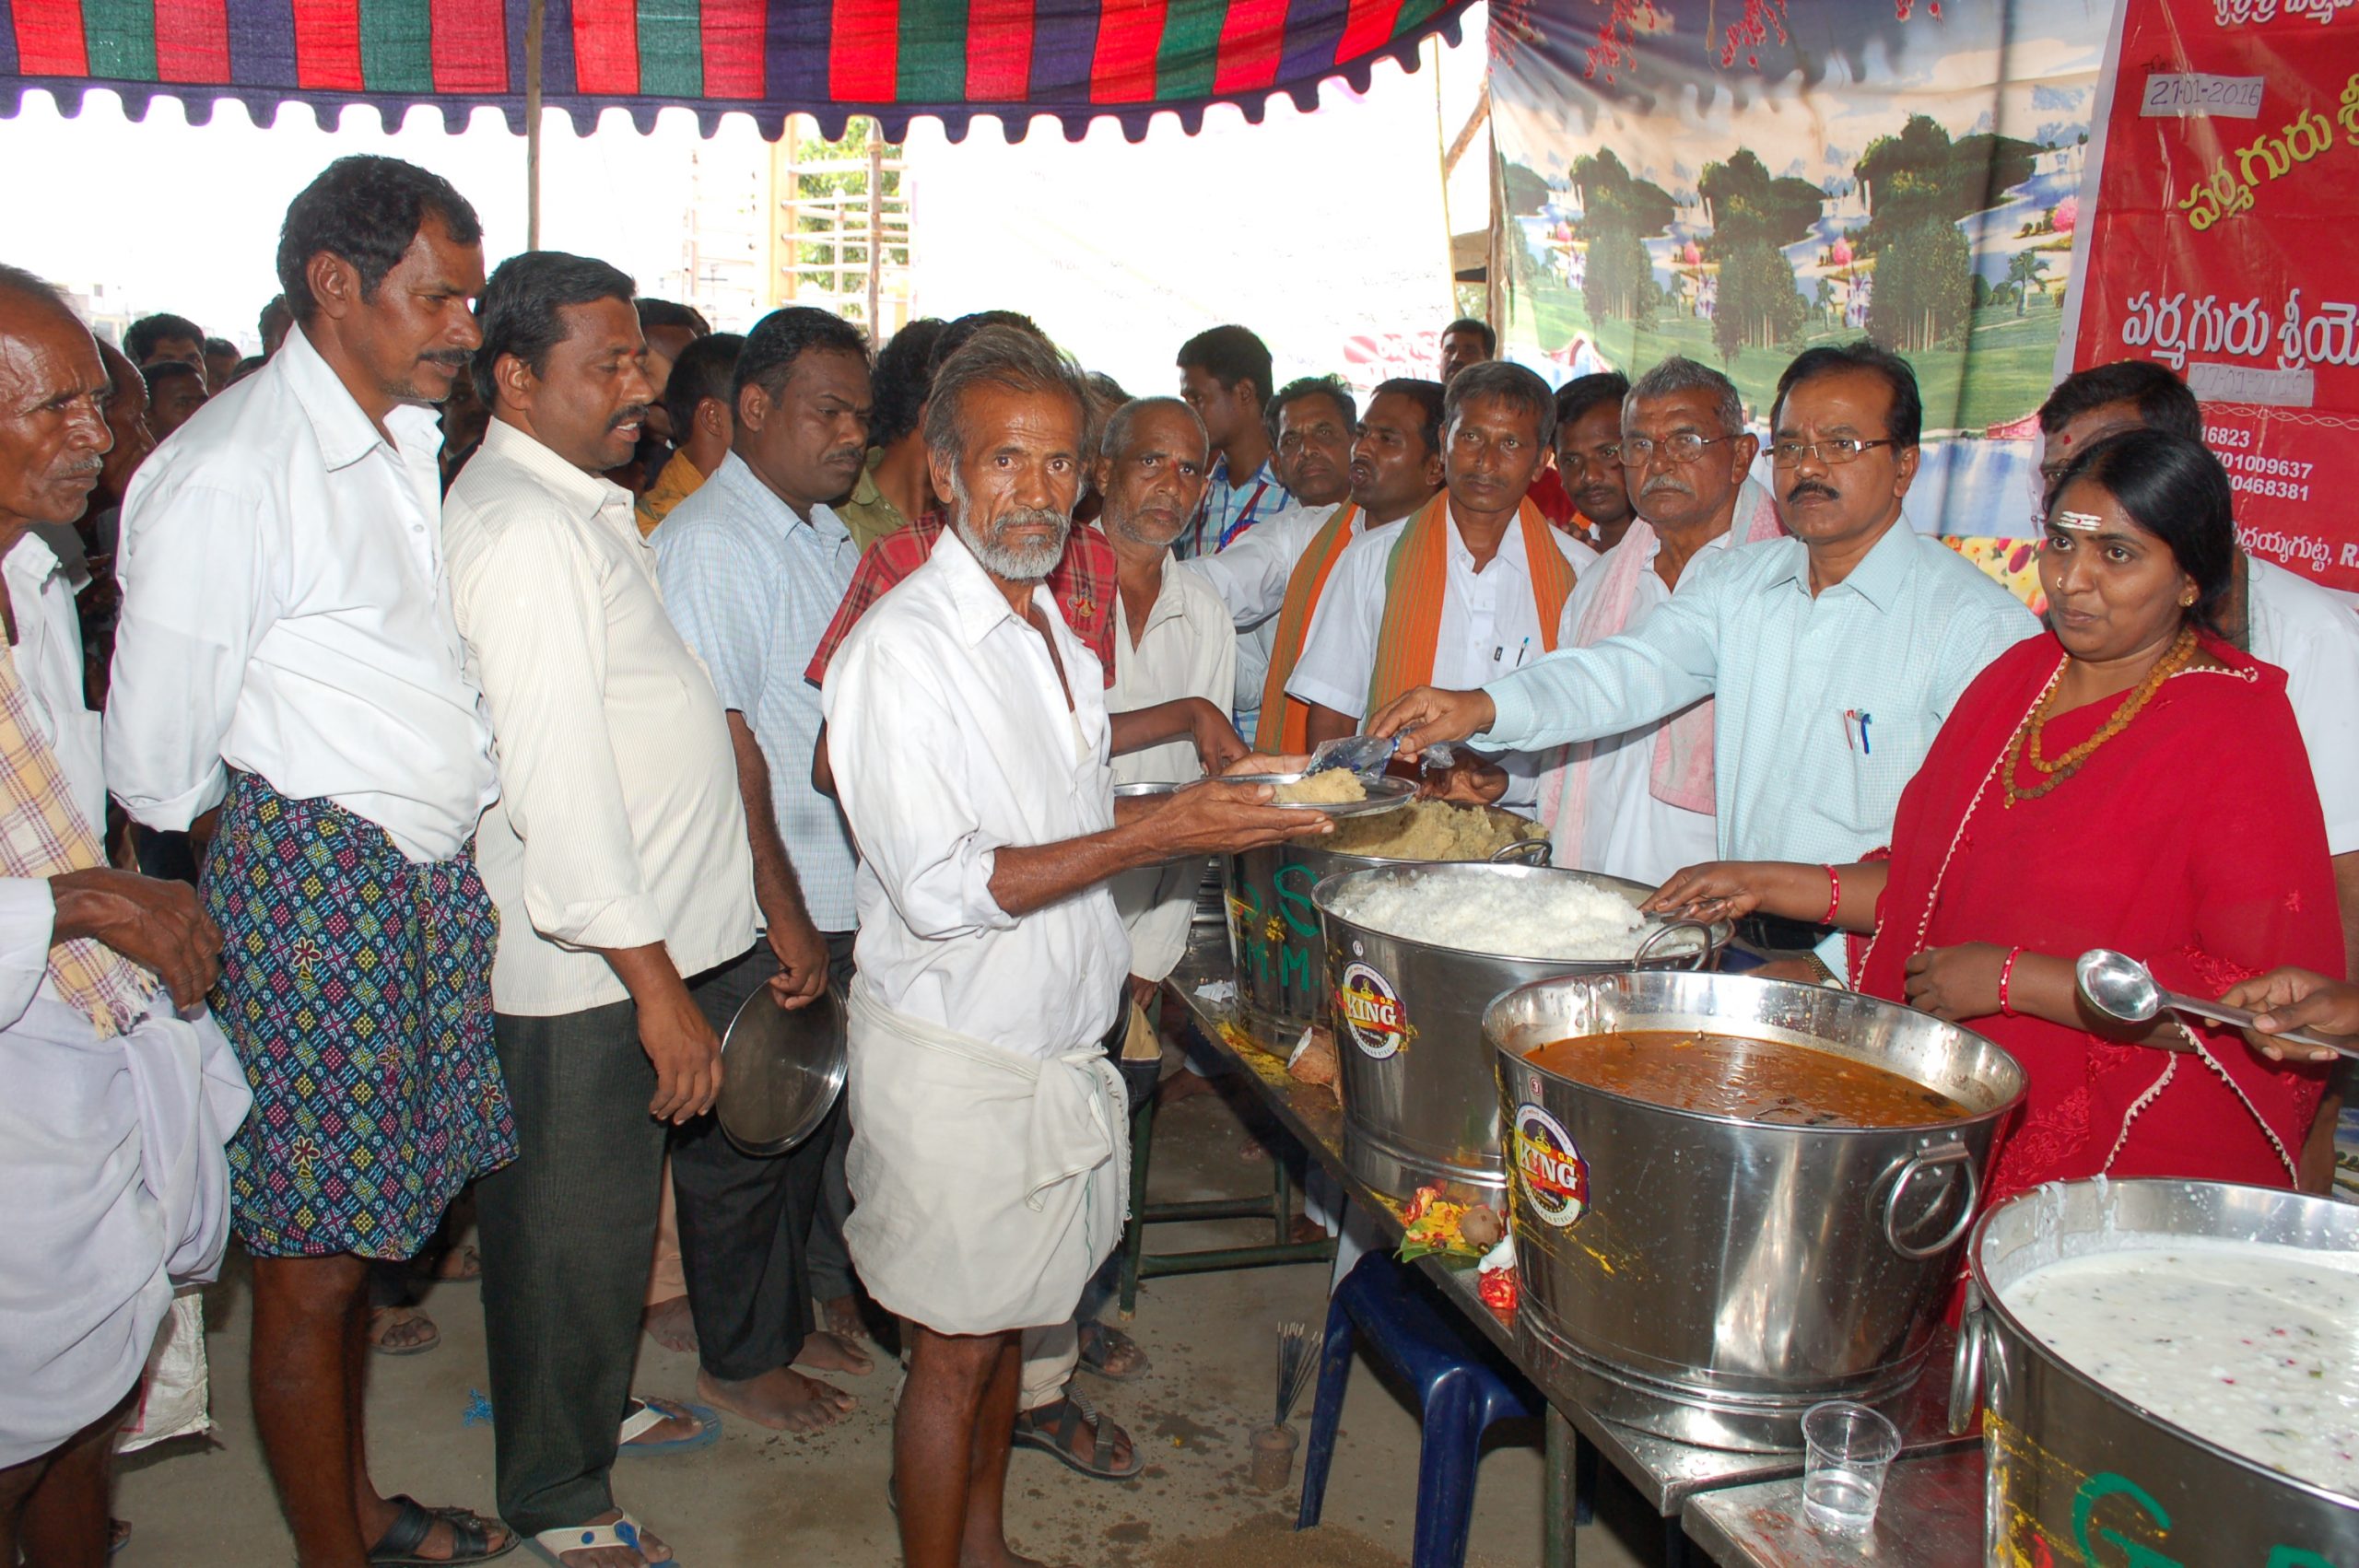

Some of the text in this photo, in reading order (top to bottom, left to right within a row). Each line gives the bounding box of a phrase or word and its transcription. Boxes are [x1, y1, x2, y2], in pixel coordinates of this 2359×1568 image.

[2225, 474, 2309, 502] 0468381
[1347, 993, 1397, 1026] KING
[1518, 1137, 1579, 1191] KING
